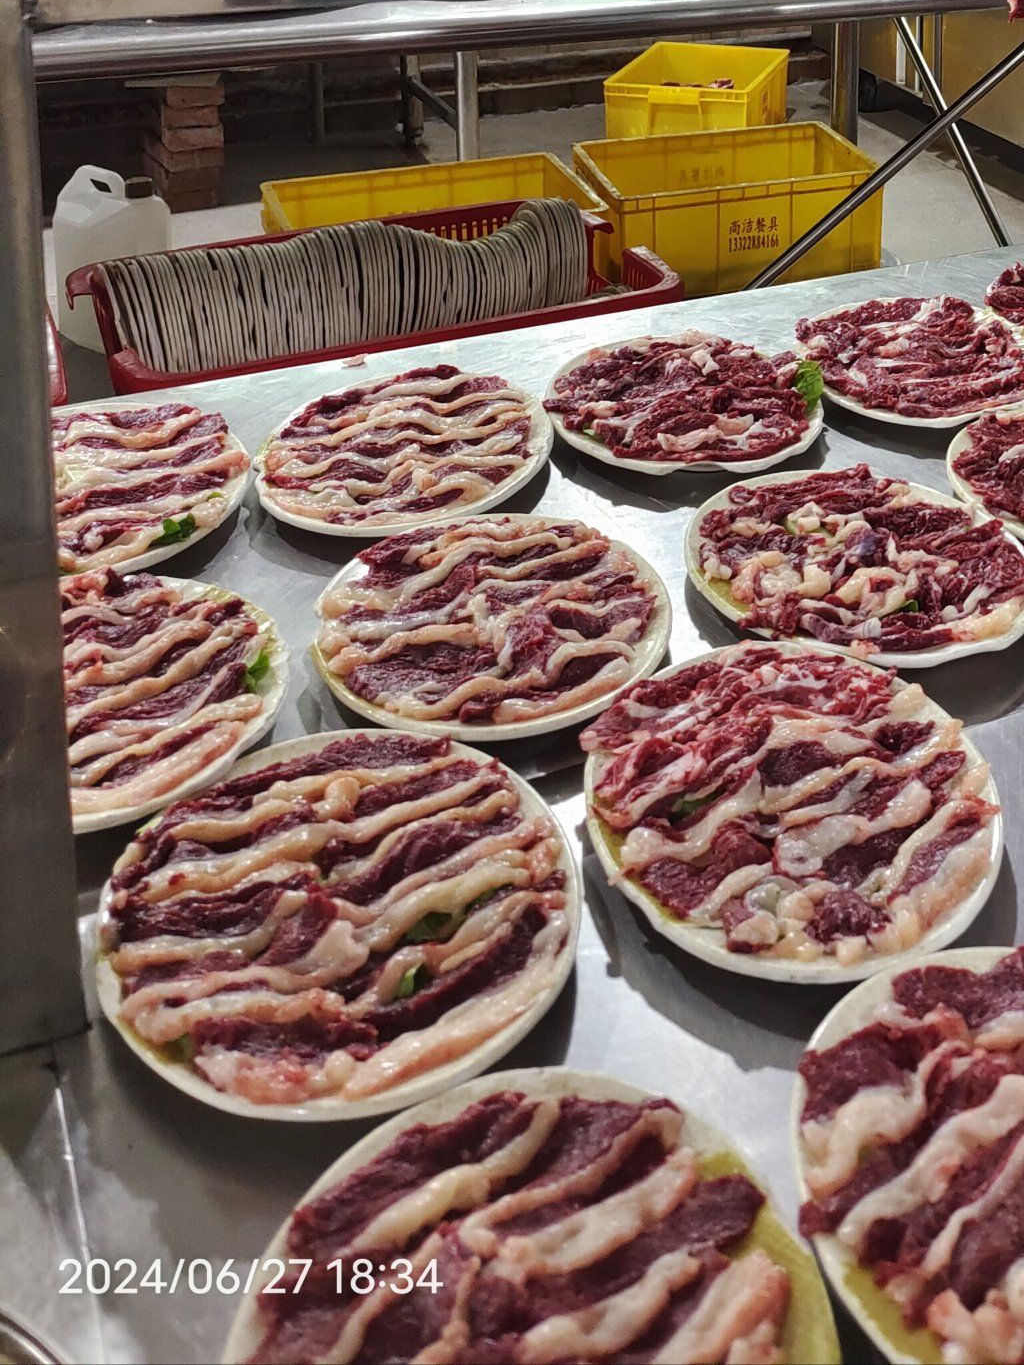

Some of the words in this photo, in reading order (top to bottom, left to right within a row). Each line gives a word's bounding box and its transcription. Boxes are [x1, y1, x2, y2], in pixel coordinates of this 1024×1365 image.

[728, 215, 779, 235] 尚洁餐具
[728, 234, 780, 253] 13322884166
